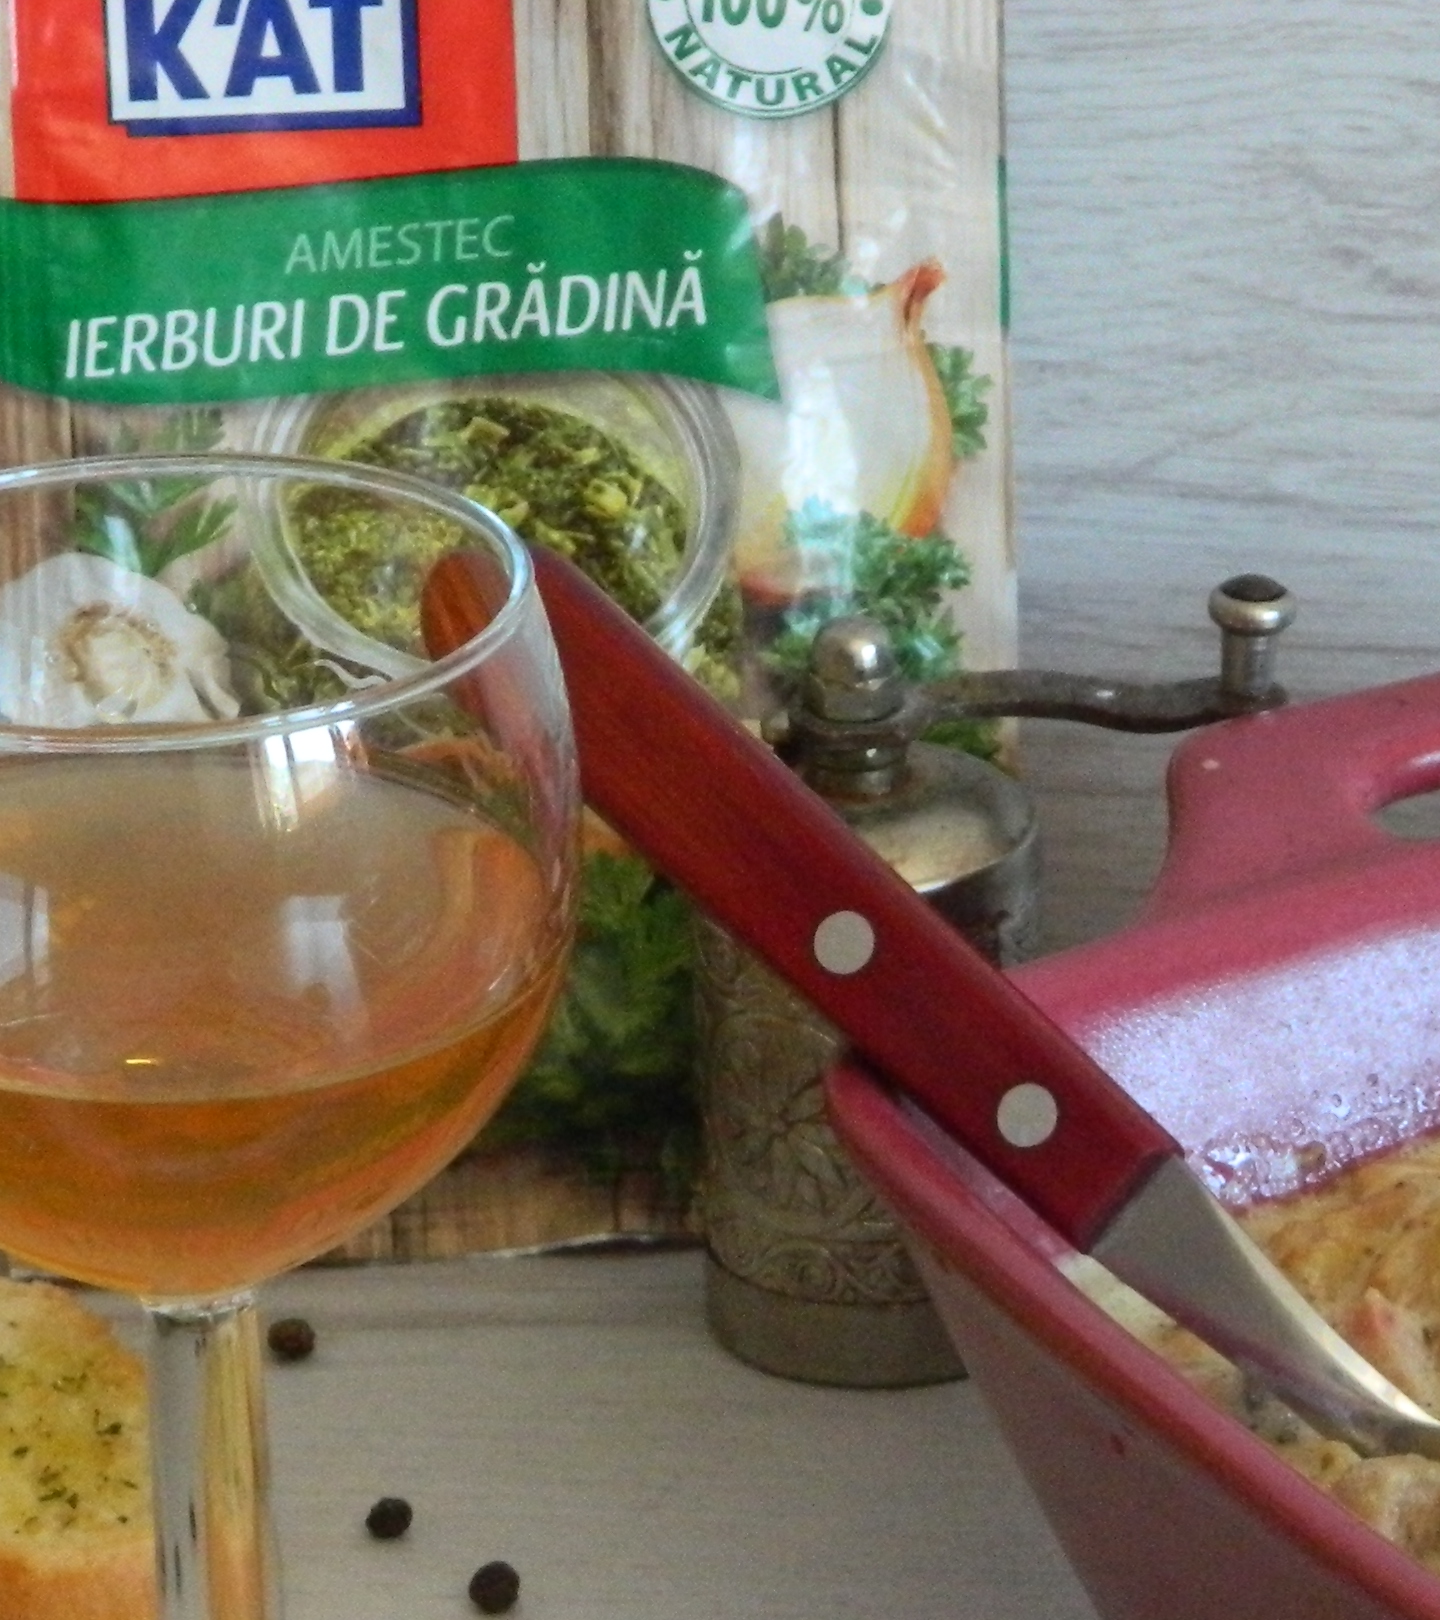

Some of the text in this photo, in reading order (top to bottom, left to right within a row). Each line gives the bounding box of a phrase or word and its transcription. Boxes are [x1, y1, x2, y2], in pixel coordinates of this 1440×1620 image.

[664, 23, 879, 106] NATURAL
[285, 215, 515, 275] AMESTEC
[65, 249, 708, 380] IERBURI DE GRĂDINĂ
